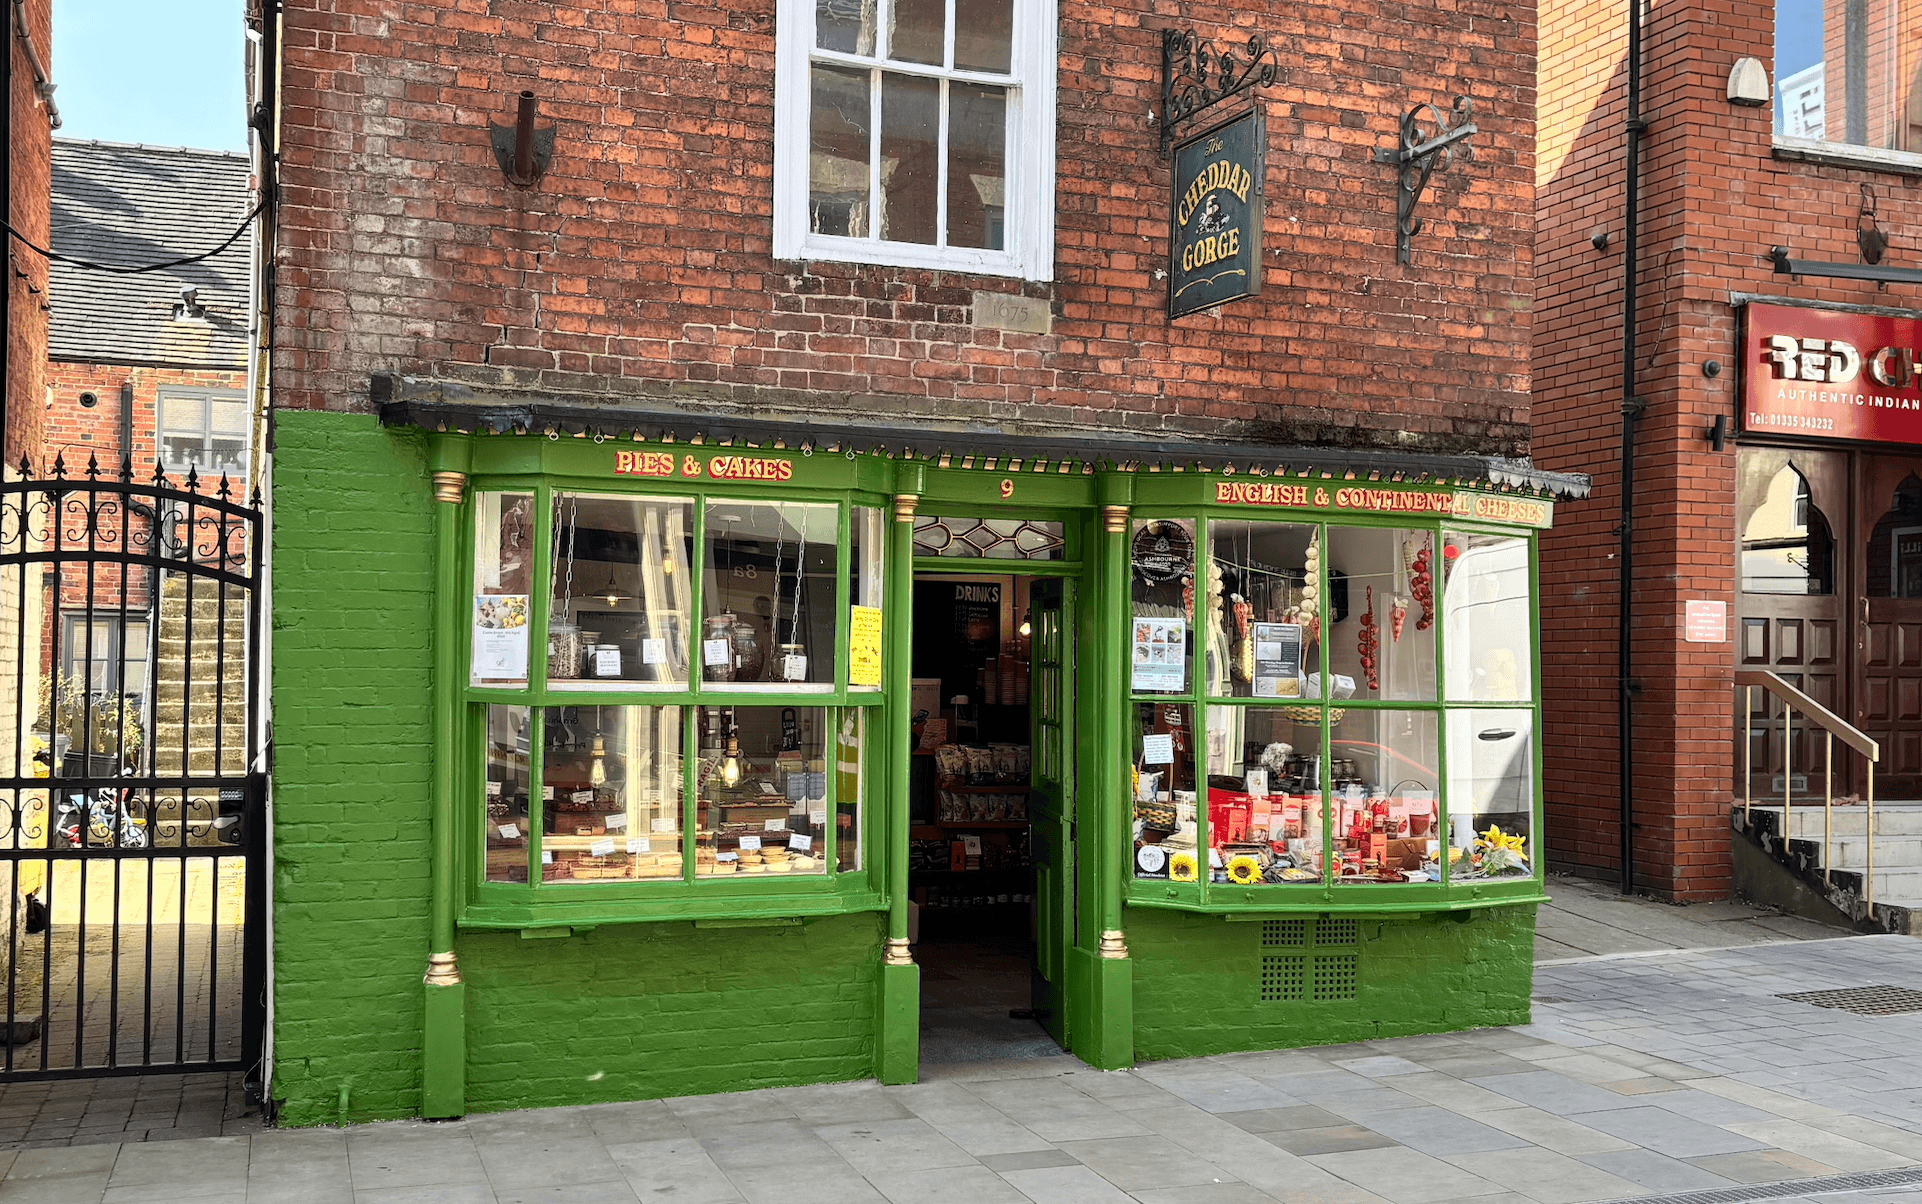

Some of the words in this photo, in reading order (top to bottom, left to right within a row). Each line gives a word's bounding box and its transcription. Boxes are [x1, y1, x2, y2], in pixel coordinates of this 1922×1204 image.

[1205, 137, 1225, 157] The
[1178, 160, 1251, 226] CHEDDAR
[1182, 228, 1240, 272] GORGE
[993, 302, 1028, 322] 1675
[1761, 335, 1860, 384] RED
[1777, 388, 1865, 406] AUTHENTIC
[1869, 395, 1920, 411] INDIAN
[1750, 412, 1768, 425] Tel:
[1770, 413, 1799, 427] 01335
[1800, 415, 1833, 430] 343232
[614, 451, 675, 477] PIES
[681, 454, 702, 478] &
[707, 455, 793, 481] CAKES
[1000, 479, 1014, 500] 9
[1215, 482, 1308, 507] ENGLISH
[1313, 487, 1330, 508] &
[1335, 488, 1471, 515] CONTINENTAL
[1475, 497, 1545, 525] CHEESES
[955, 584, 999, 603] DRINKS
